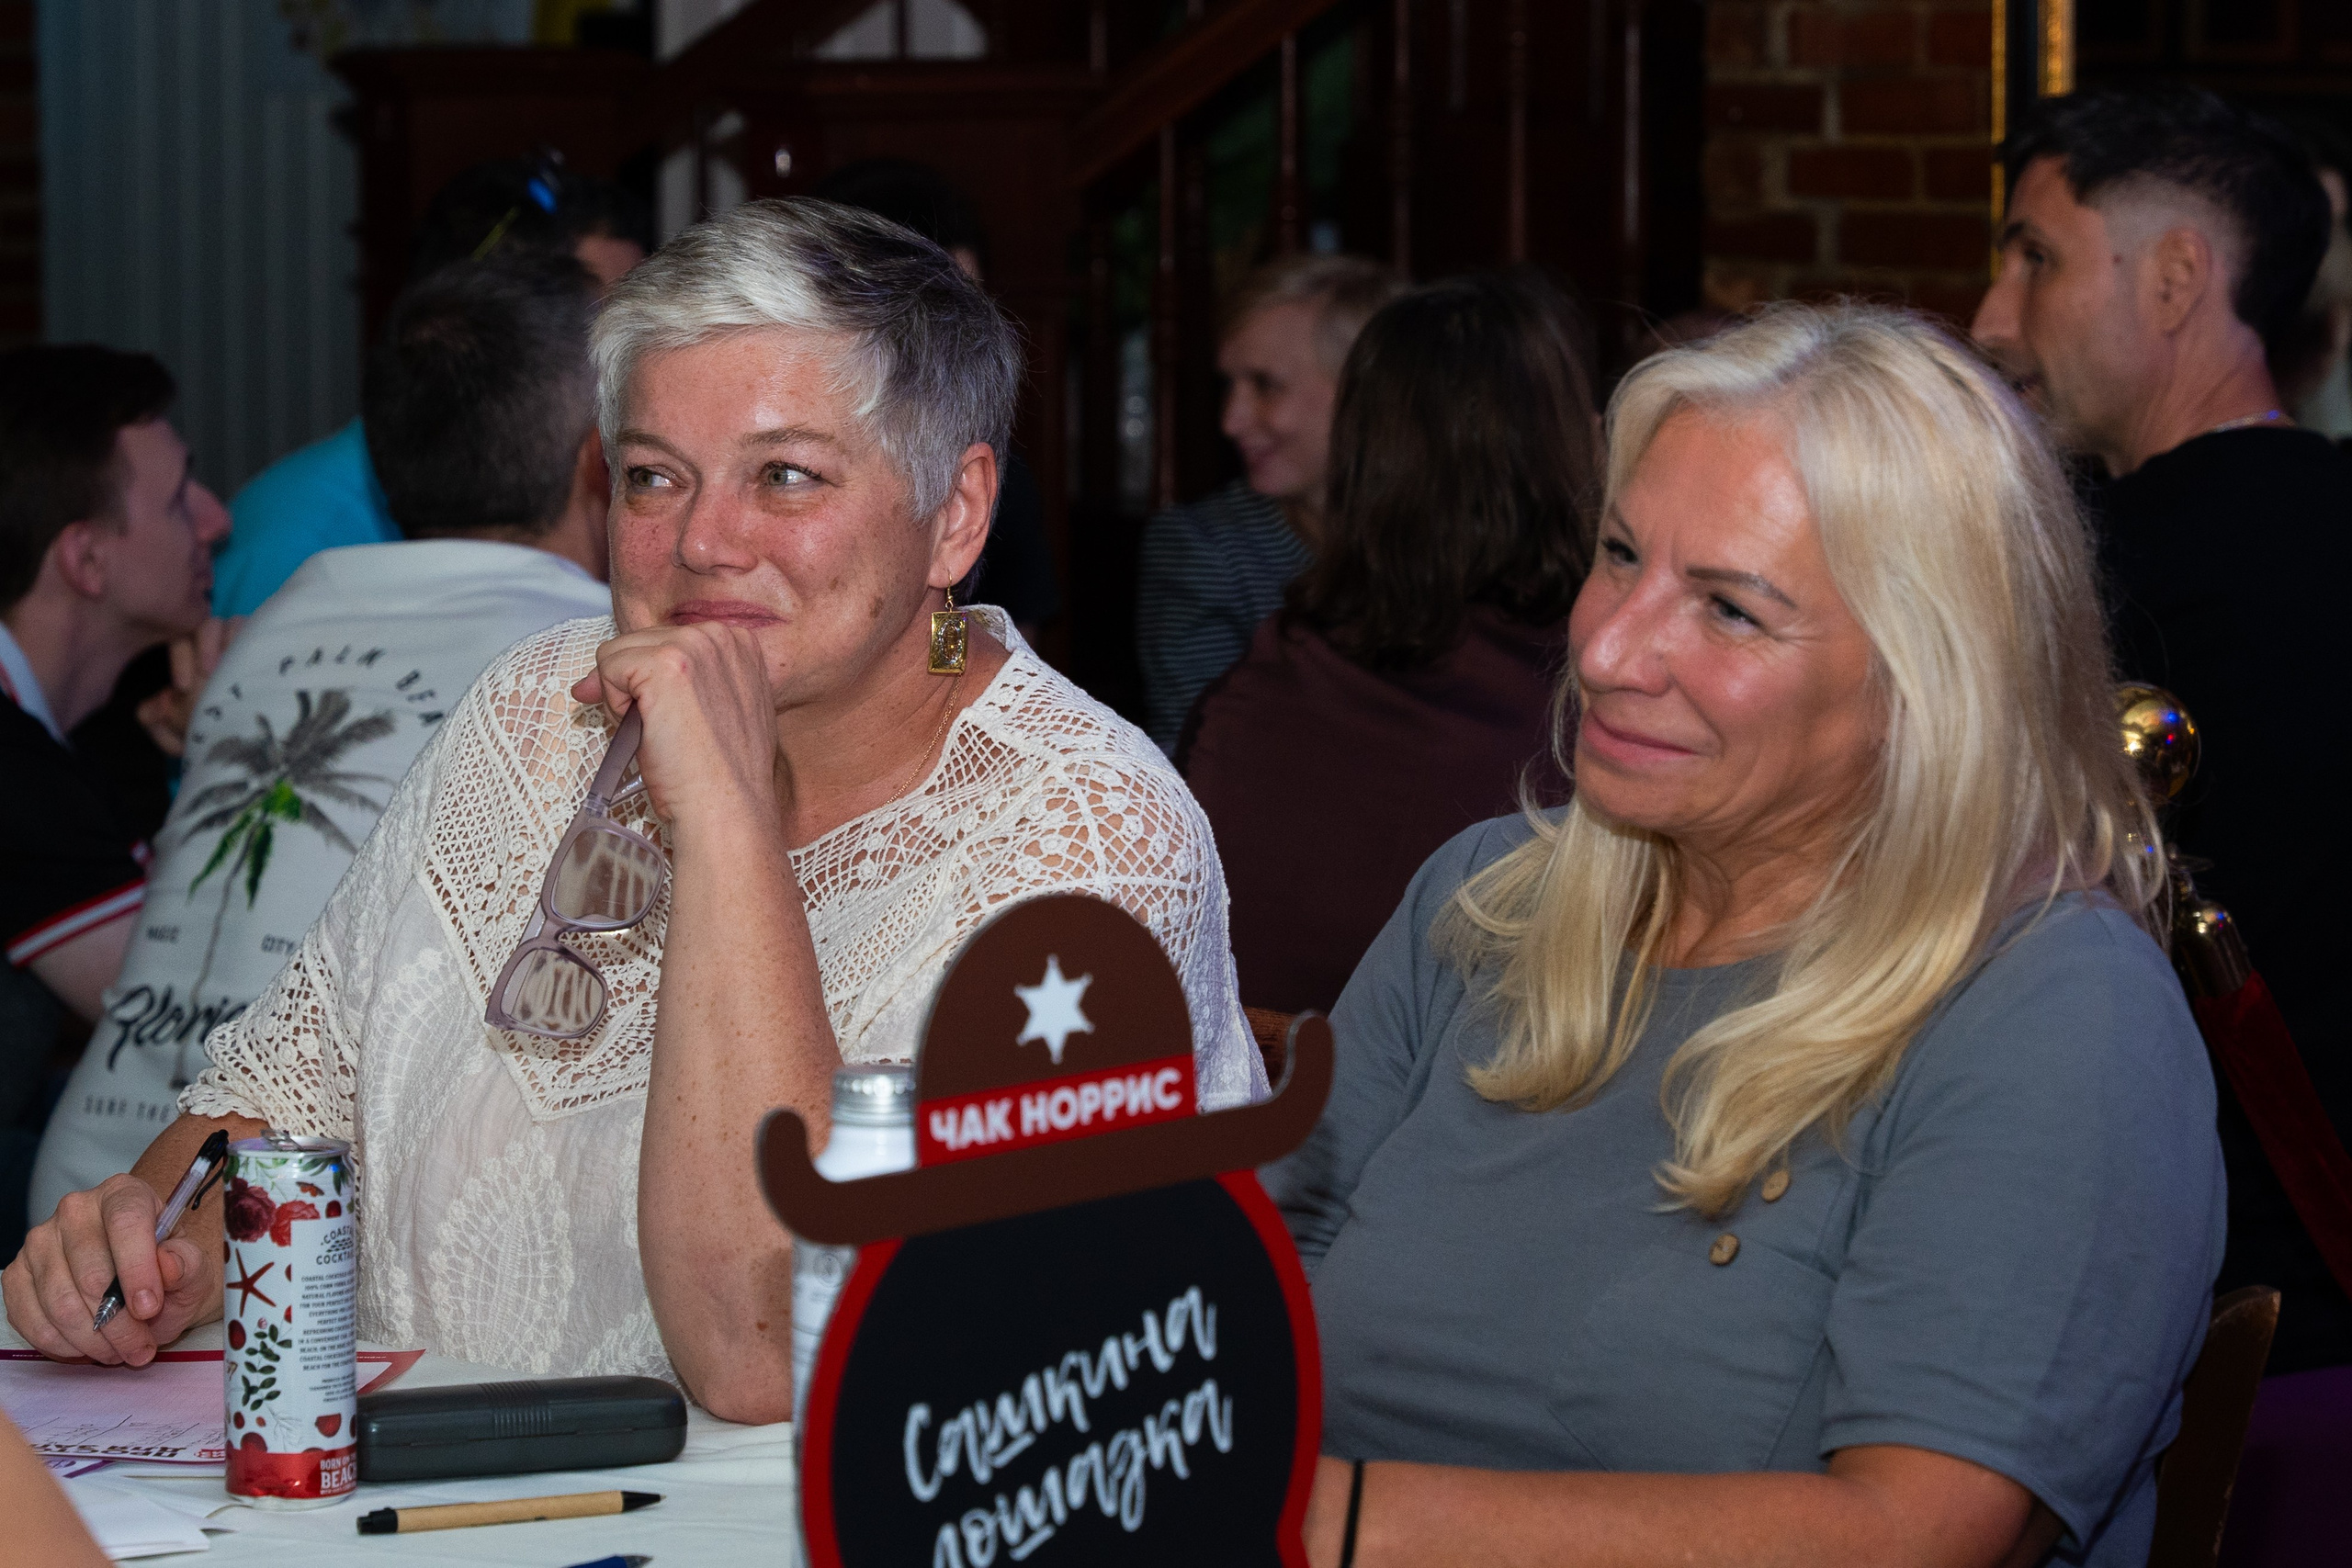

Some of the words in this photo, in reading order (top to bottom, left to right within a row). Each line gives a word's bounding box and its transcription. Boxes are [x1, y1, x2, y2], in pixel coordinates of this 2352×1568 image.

[928, 1096, 1014, 1151] ЧАК
[1019, 1066, 1182, 1137] НОРРИС
[903, 1285, 1217, 1502] Сашкина
[320, 1458, 341, 1470] BORN
[933, 1379, 1232, 1568] лошадка
